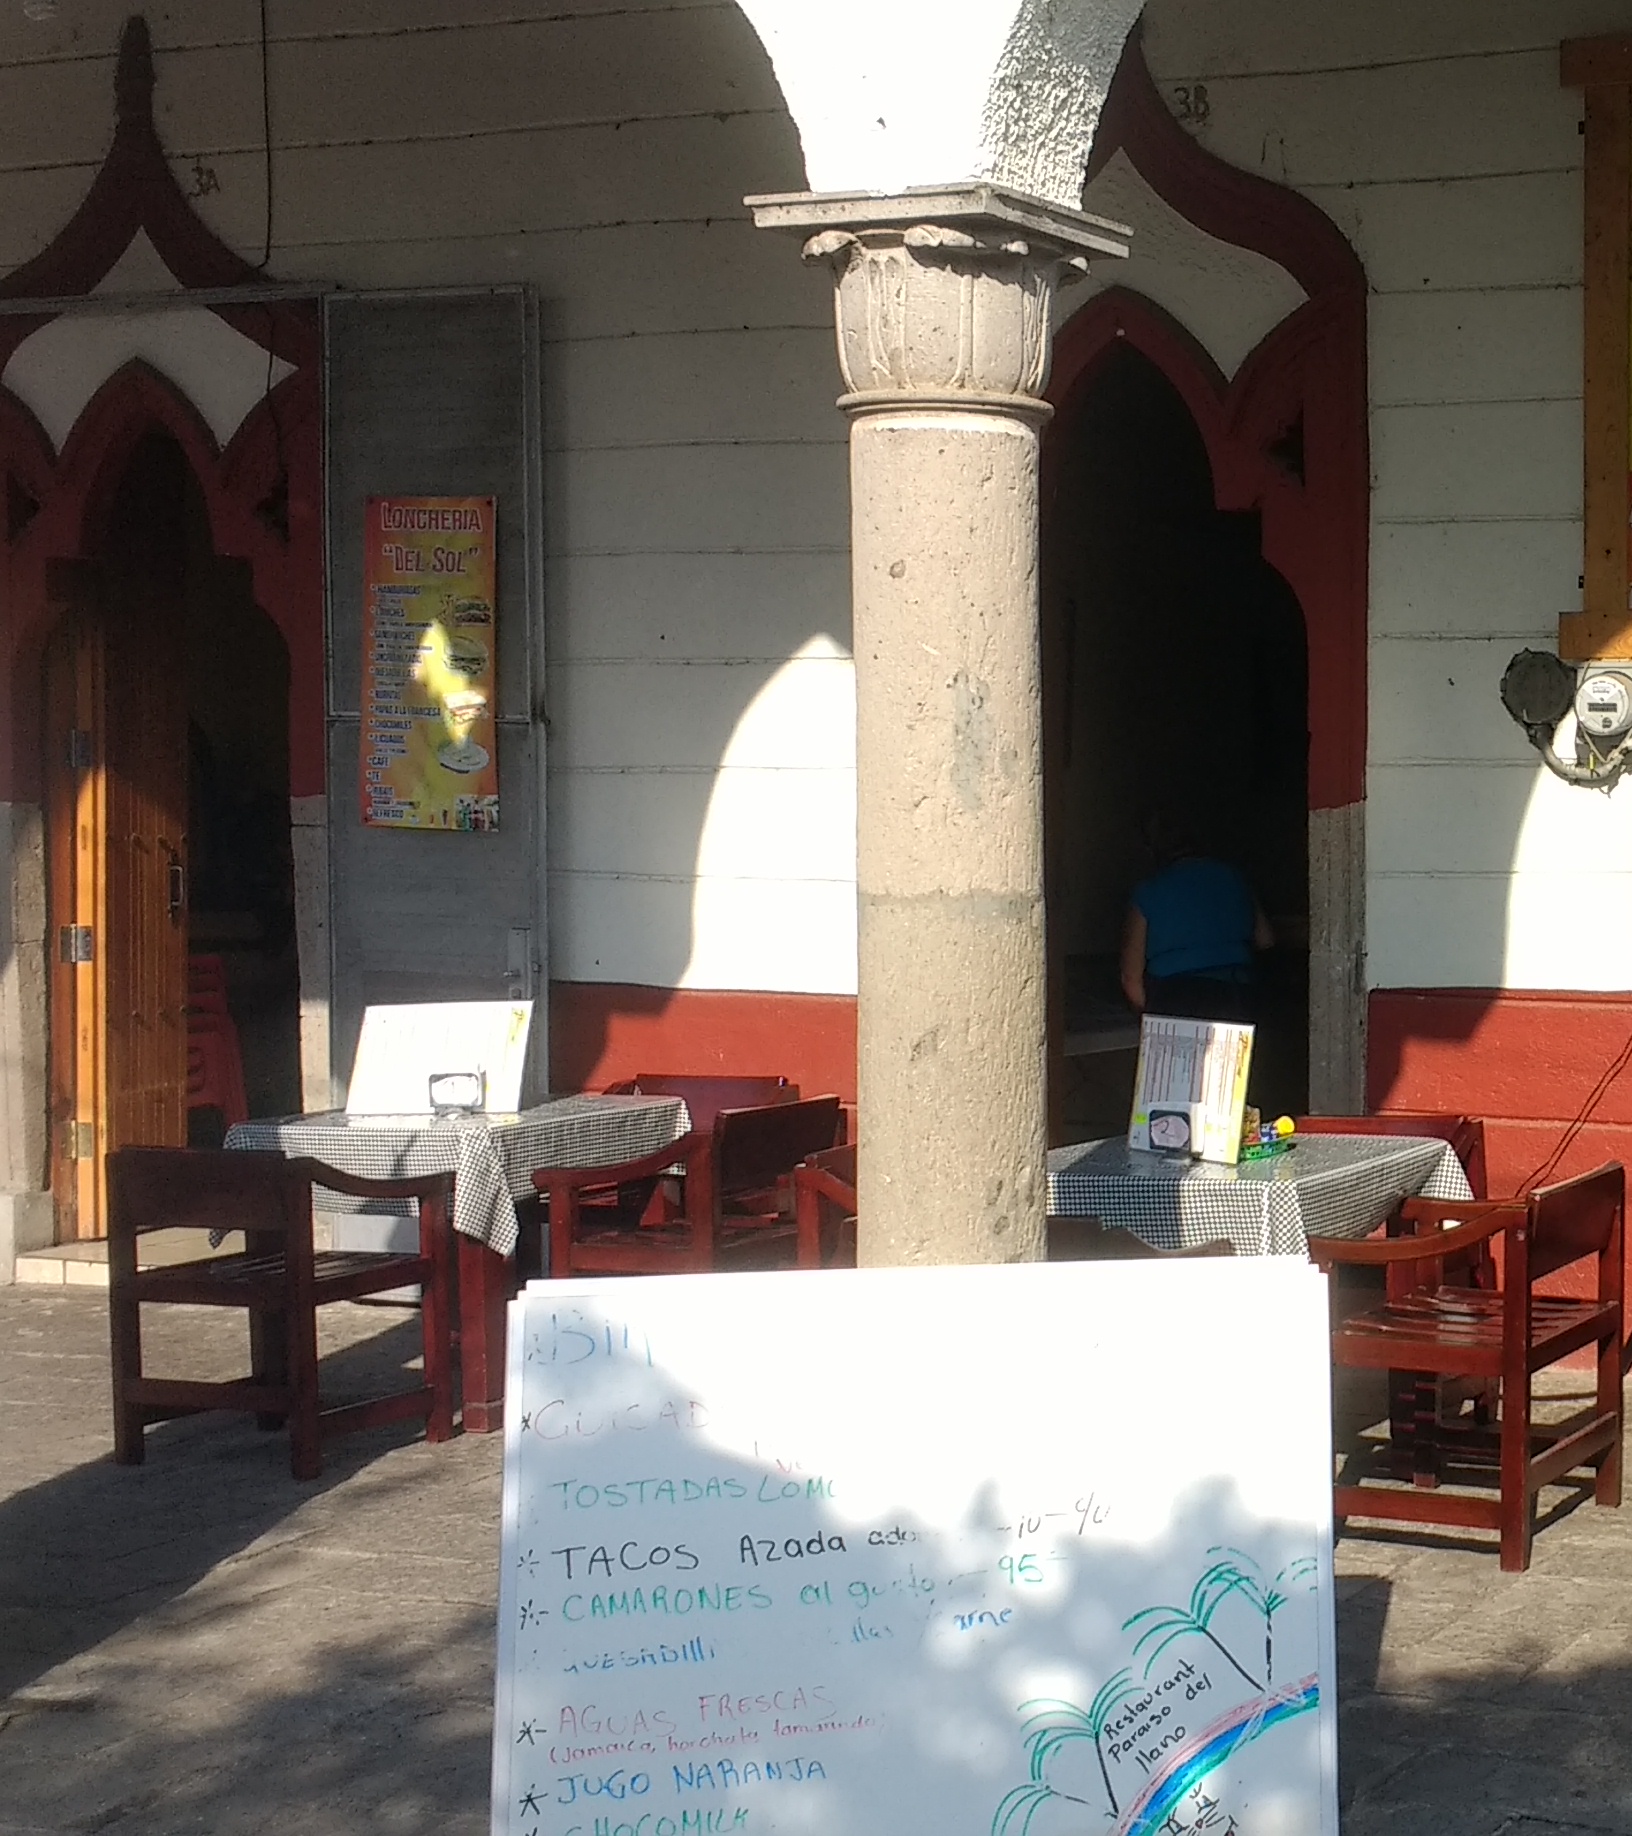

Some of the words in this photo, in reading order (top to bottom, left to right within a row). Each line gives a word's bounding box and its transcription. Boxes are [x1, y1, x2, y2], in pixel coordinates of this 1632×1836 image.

[381, 502, 481, 531] LONCHERIA
[552, 1477, 748, 1510] TOSTADAS
[551, 1541, 699, 1579] TACOS
[739, 1530, 847, 1566] Azada
[562, 1583, 773, 1622] CAMARONES
[558, 1704, 678, 1738] AGUAS
[698, 1685, 838, 1722] FRESCAS
[1103, 1658, 1195, 1741] Restaurant
[1108, 1704, 1172, 1764] Paraiso
[1184, 1671, 1213, 1702] del
[1134, 1724, 1187, 1775] llano
[557, 1771, 652, 1804] JUGO
[673, 1757, 828, 1794] NARANJA
